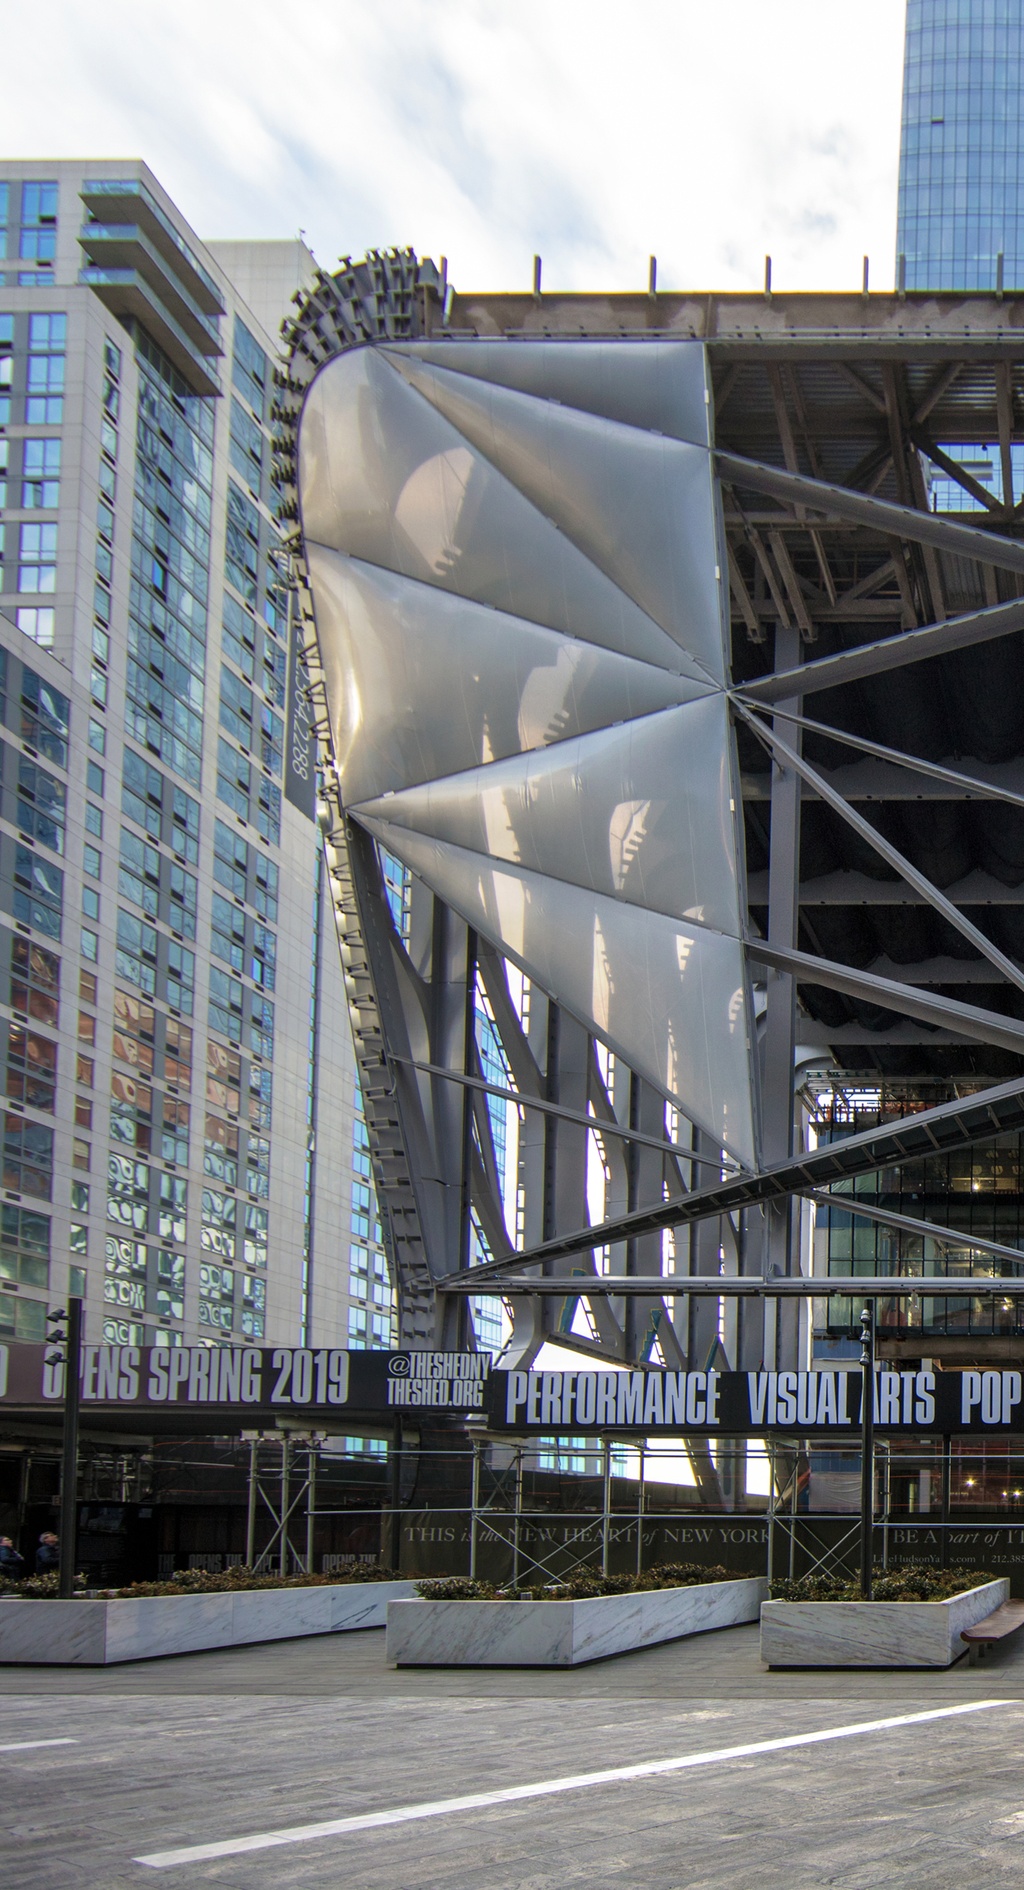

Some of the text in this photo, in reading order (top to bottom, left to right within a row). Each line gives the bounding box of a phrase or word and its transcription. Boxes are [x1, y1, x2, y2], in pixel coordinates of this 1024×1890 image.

[148, 1347, 263, 1402] SPRING
[271, 1349, 350, 1404] 2019
[388, 1351, 491, 1380] @THESHEDNY
[387, 1378, 483, 1407] THESHED.ORG
[506, 1371, 721, 1424] PERFORMANCE
[747, 1371, 851, 1424] VISUAL
[961, 1370, 1022, 1424] POP
[403, 1527, 456, 1542] THIS
[508, 1527, 557, 1542] NEW
[563, 1527, 637, 1543] HEART
[641, 1528, 659, 1546] of
[664, 1528, 714, 1543] NEW
[893, 1529, 919, 1544] BE
[923, 1529, 938, 1544] A
[983, 1529, 1003, 1547] of
